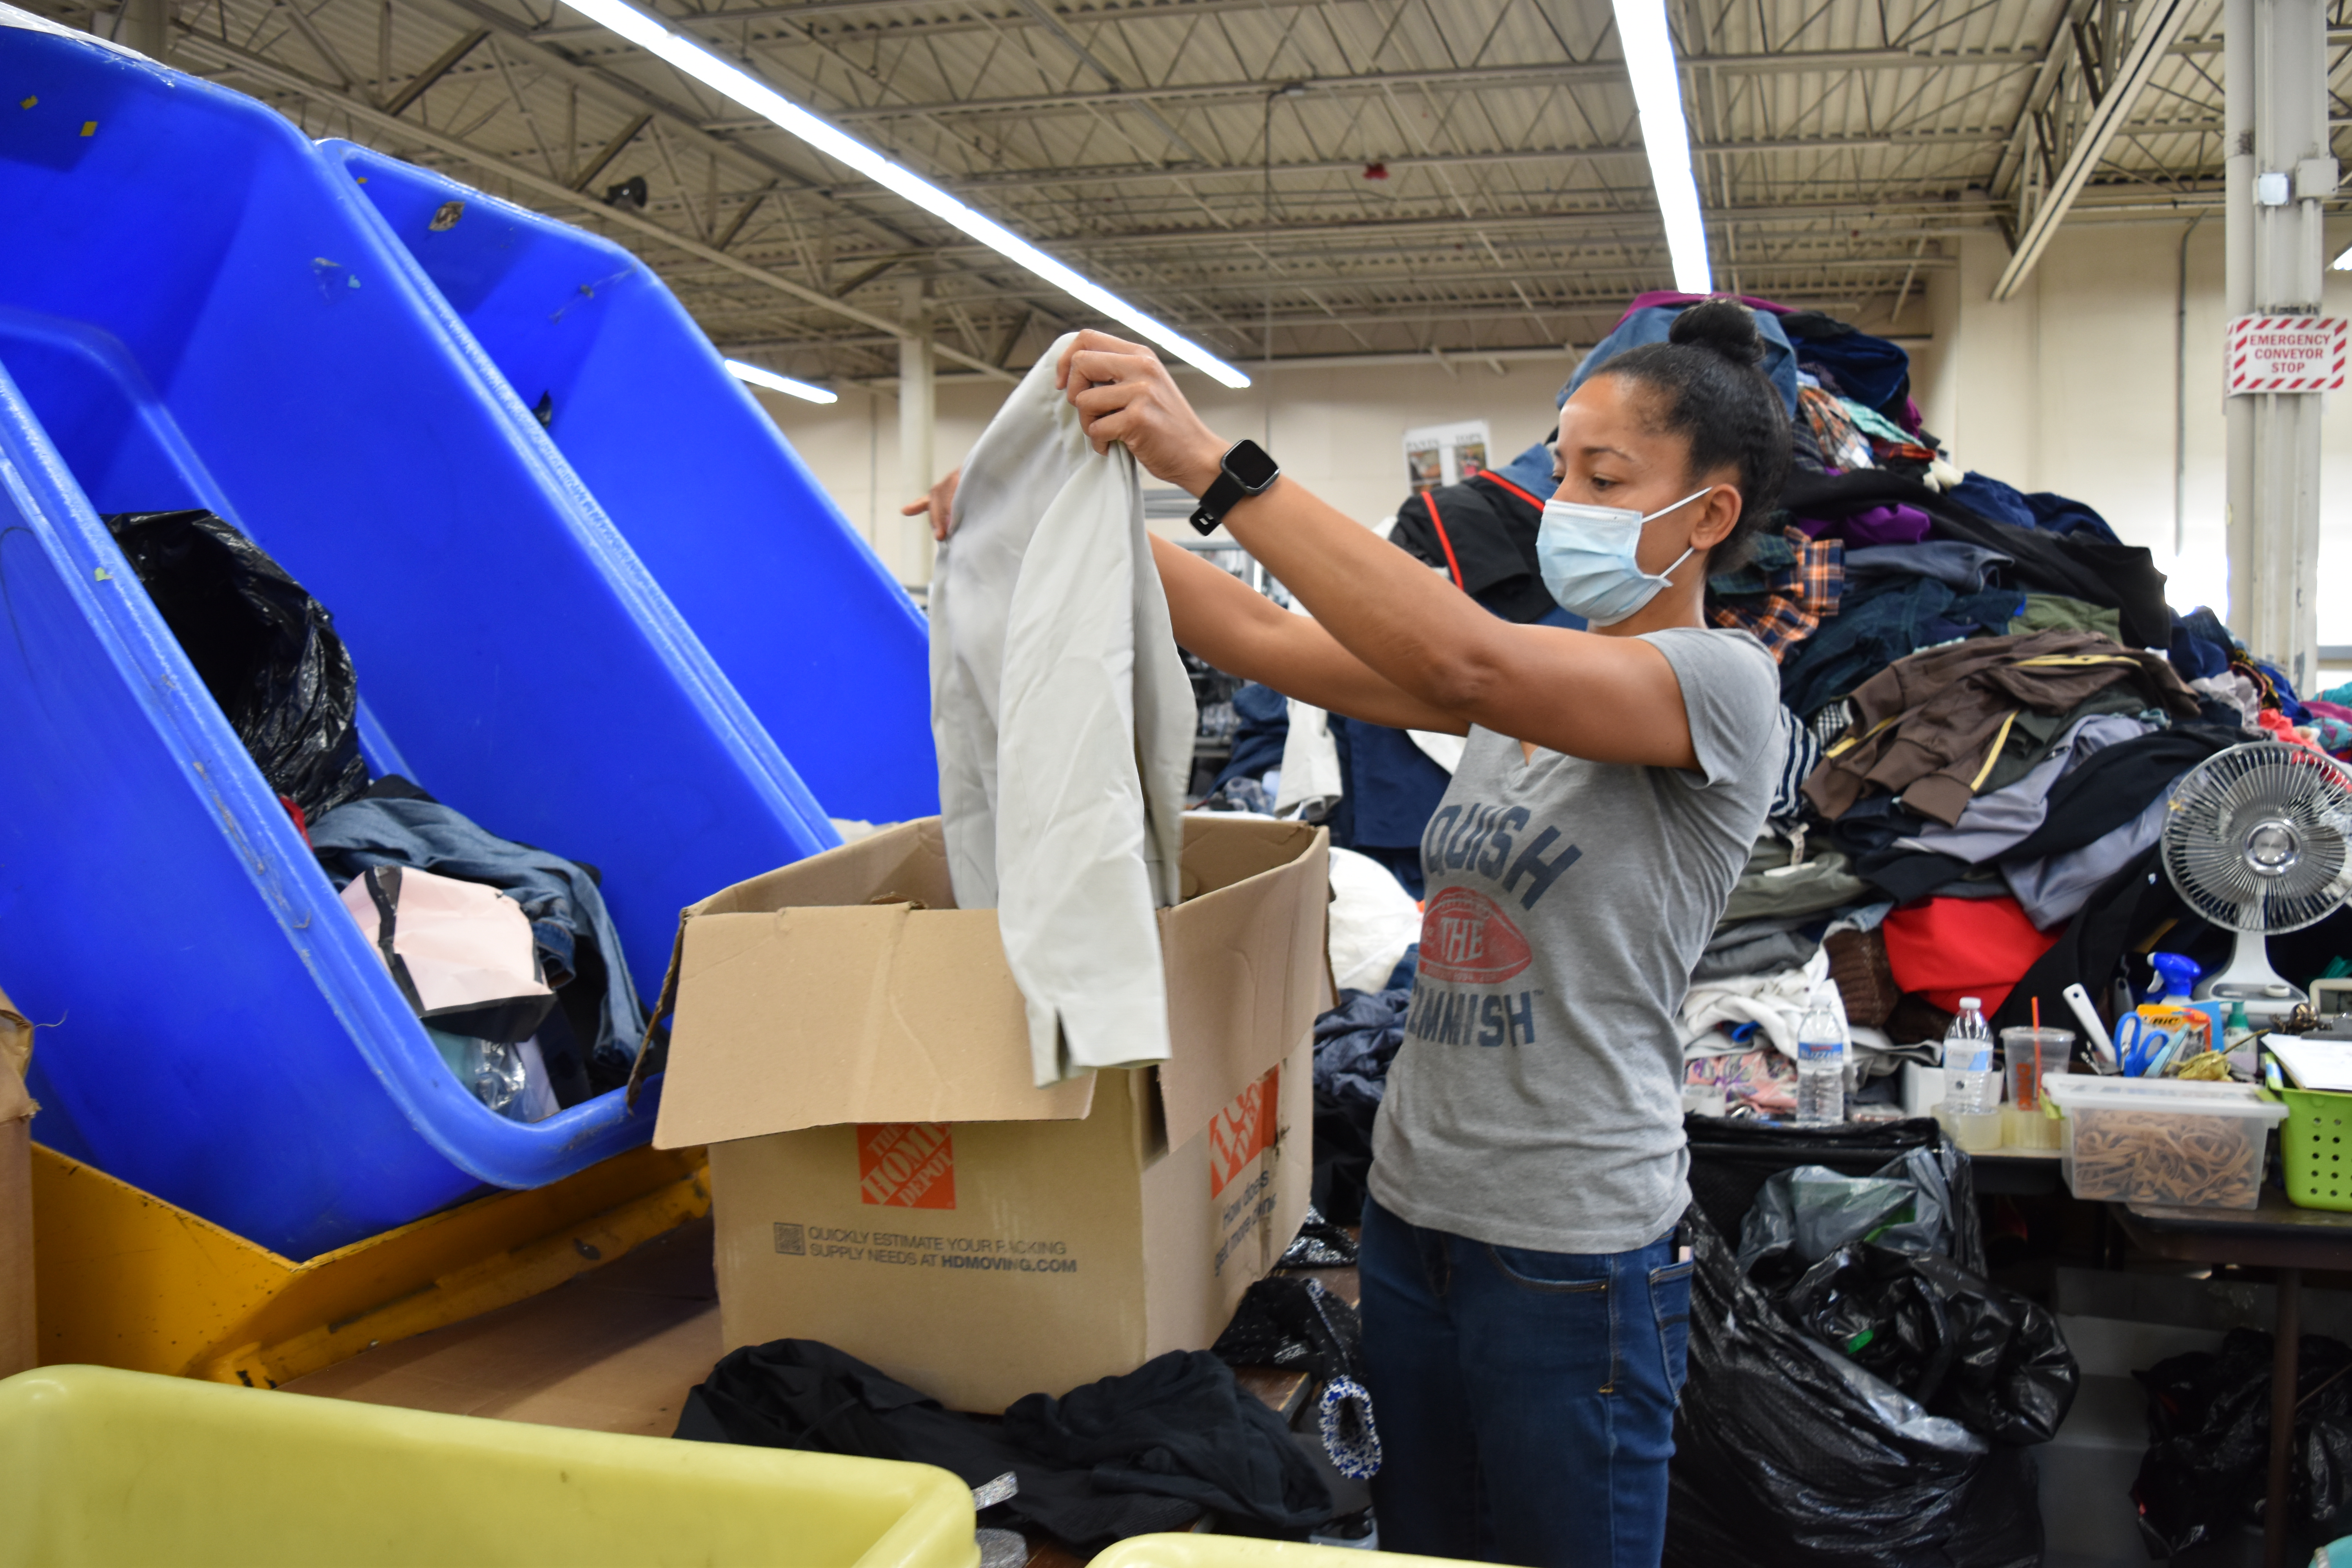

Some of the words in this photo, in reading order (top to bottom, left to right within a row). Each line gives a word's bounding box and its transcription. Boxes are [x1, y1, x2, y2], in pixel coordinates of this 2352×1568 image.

[2250, 334, 2331, 345] EMERGENCY
[2255, 348, 2323, 359] CONVEYOR
[2271, 362, 2305, 373] STOP
[1441, 916, 1484, 963] THE
[867, 1124, 902, 1156] THE
[898, 1146, 953, 1207] DEPOT
[808, 1226, 869, 1244] QUICKLY
[873, 1232, 944, 1250] ESTIMATE
[946, 1238, 993, 1252] YOUR
[810, 1243, 864, 1260] SUPPLY
[868, 1249, 918, 1265] NEEDS
[920, 1254, 938, 1267] AT
[942, 1255, 1077, 1273] HDMOVING.COM
